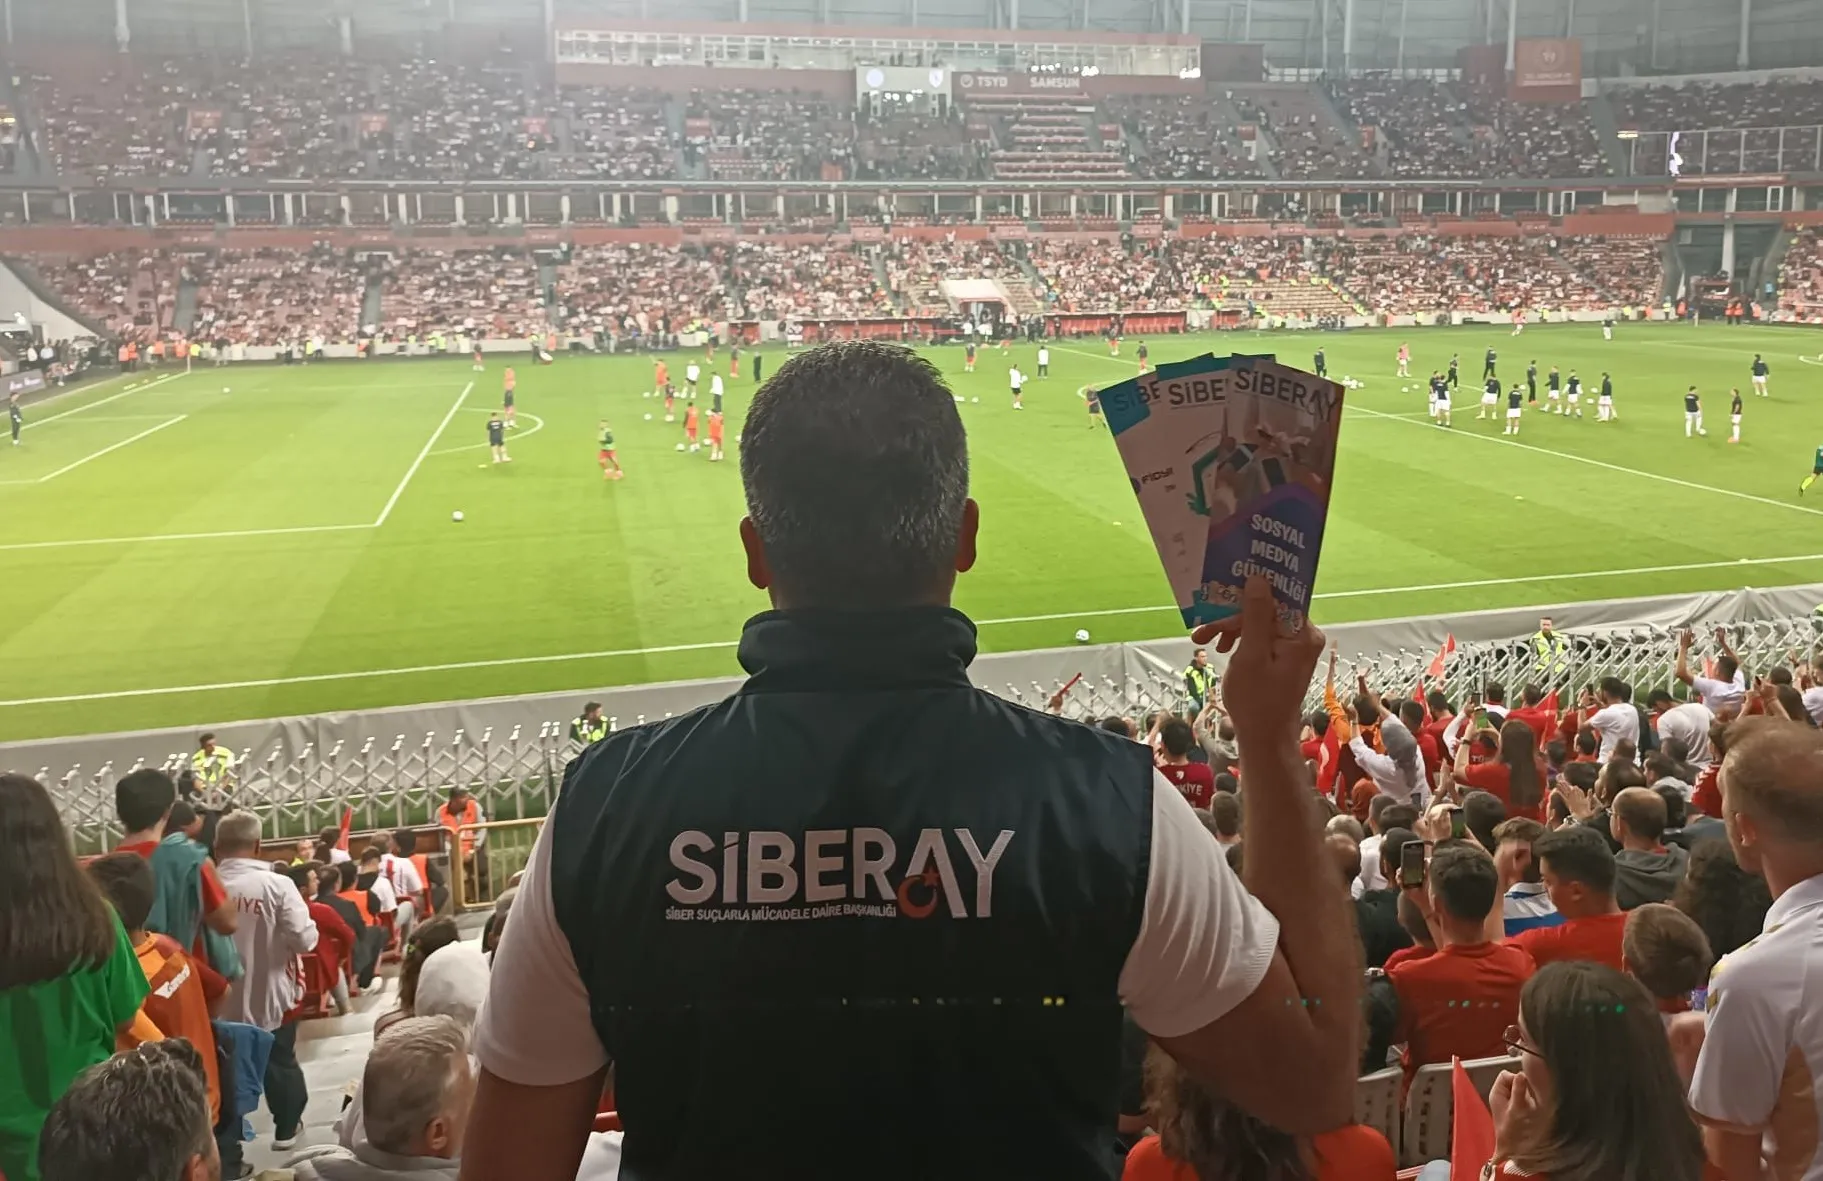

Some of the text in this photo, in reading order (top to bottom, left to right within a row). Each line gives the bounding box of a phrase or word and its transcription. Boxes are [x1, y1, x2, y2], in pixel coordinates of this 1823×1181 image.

[1029, 76, 1080, 88] SAMSUN
[1251, 514, 1306, 549] SOSYAL
[1251, 539, 1299, 573] MEDYA
[665, 905, 695, 921] SİBER
[751, 905, 811, 921] MÜCADELE
[811, 903, 843, 919] DAİRE
